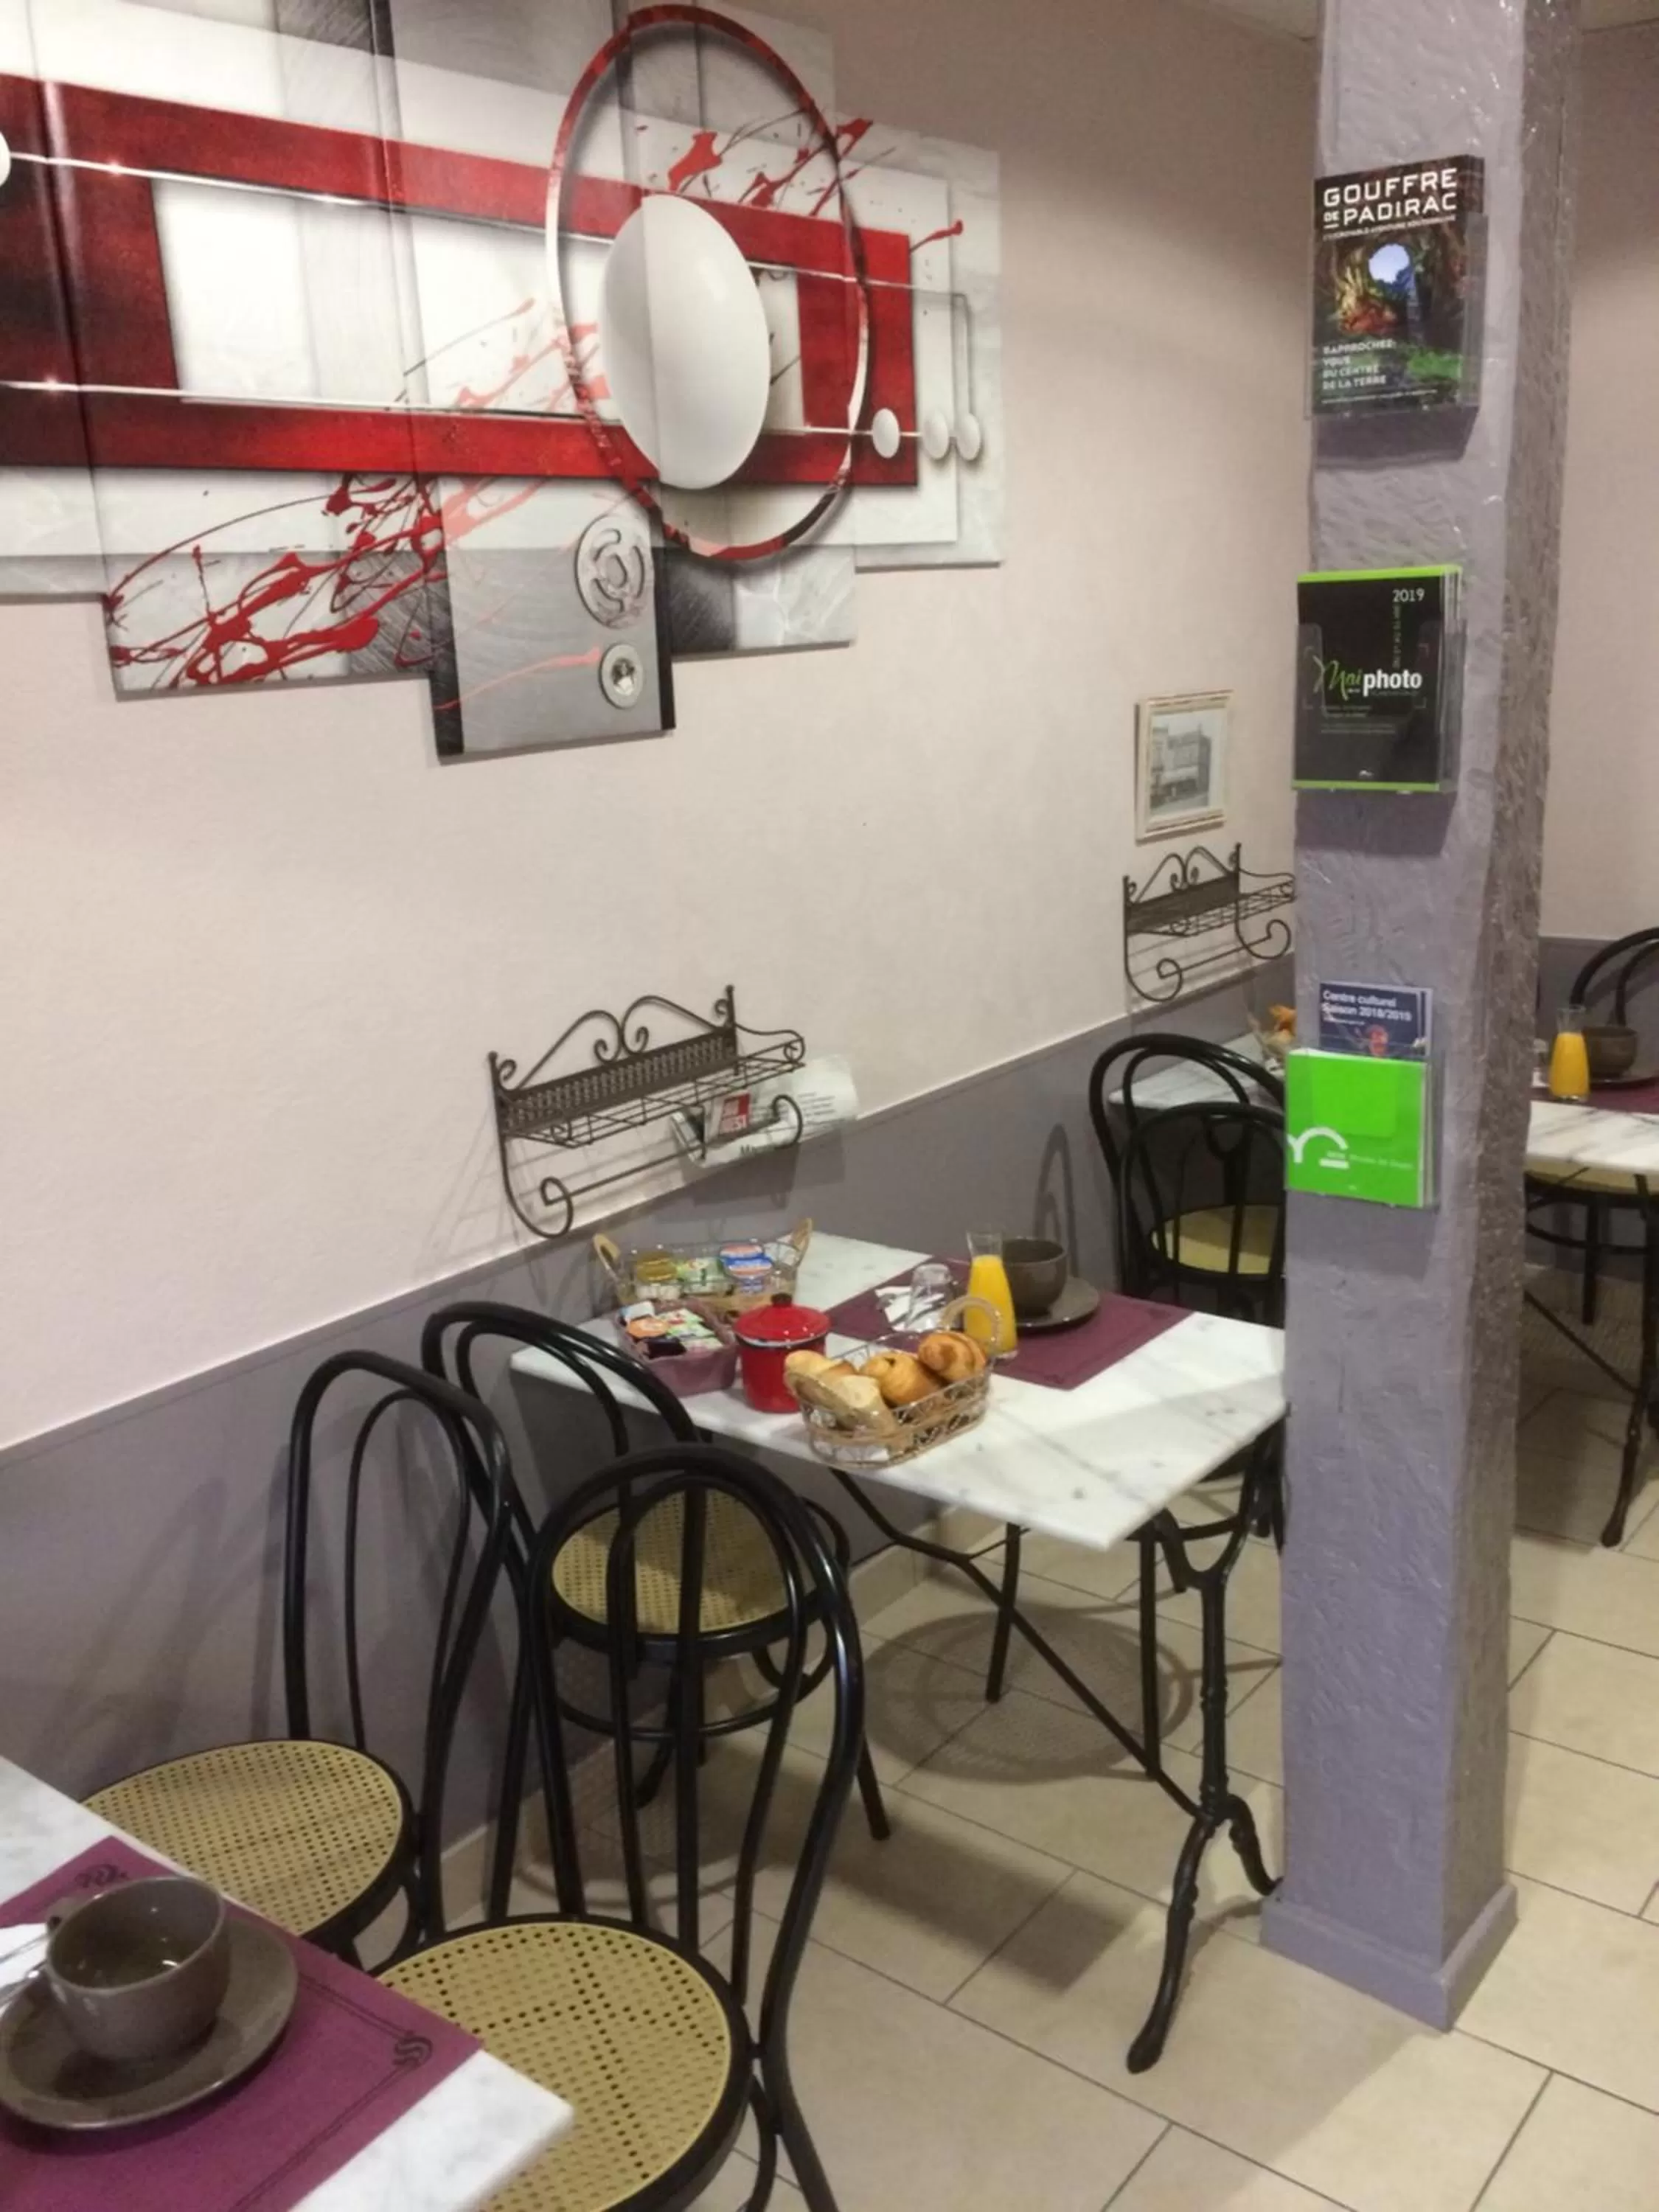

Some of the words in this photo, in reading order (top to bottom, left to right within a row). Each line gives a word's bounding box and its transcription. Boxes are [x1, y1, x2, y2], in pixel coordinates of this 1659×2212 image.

[1324, 168, 1457, 207] GOUFFRE
[1324, 211, 1339, 221] DE
[1343, 192, 1457, 226] PADIRAC
[1392, 588, 1425, 602] 2019
[1323, 990, 1357, 1004] Centre
